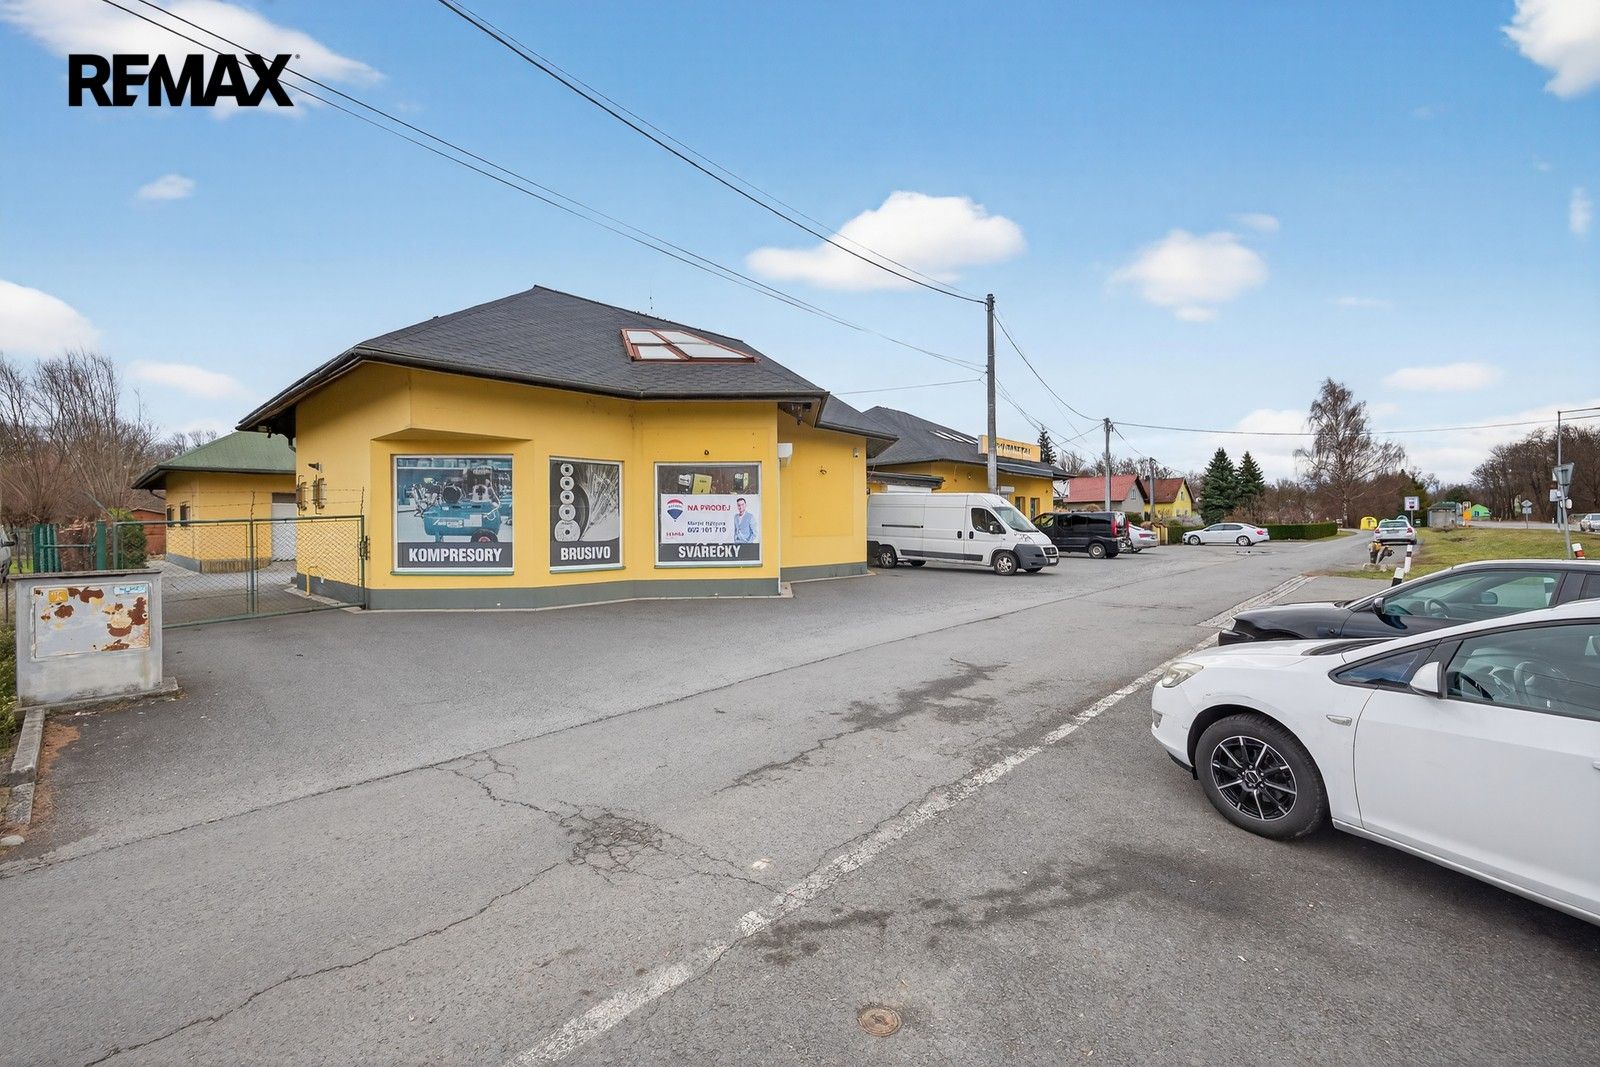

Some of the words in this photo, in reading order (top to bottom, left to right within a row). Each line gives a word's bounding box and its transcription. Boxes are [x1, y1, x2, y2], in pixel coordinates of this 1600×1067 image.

[408, 548, 502, 564] KOMPRESORY
[560, 545, 611, 562] BRUSIVO
[678, 543, 741, 558] SVÁŘEČKY
